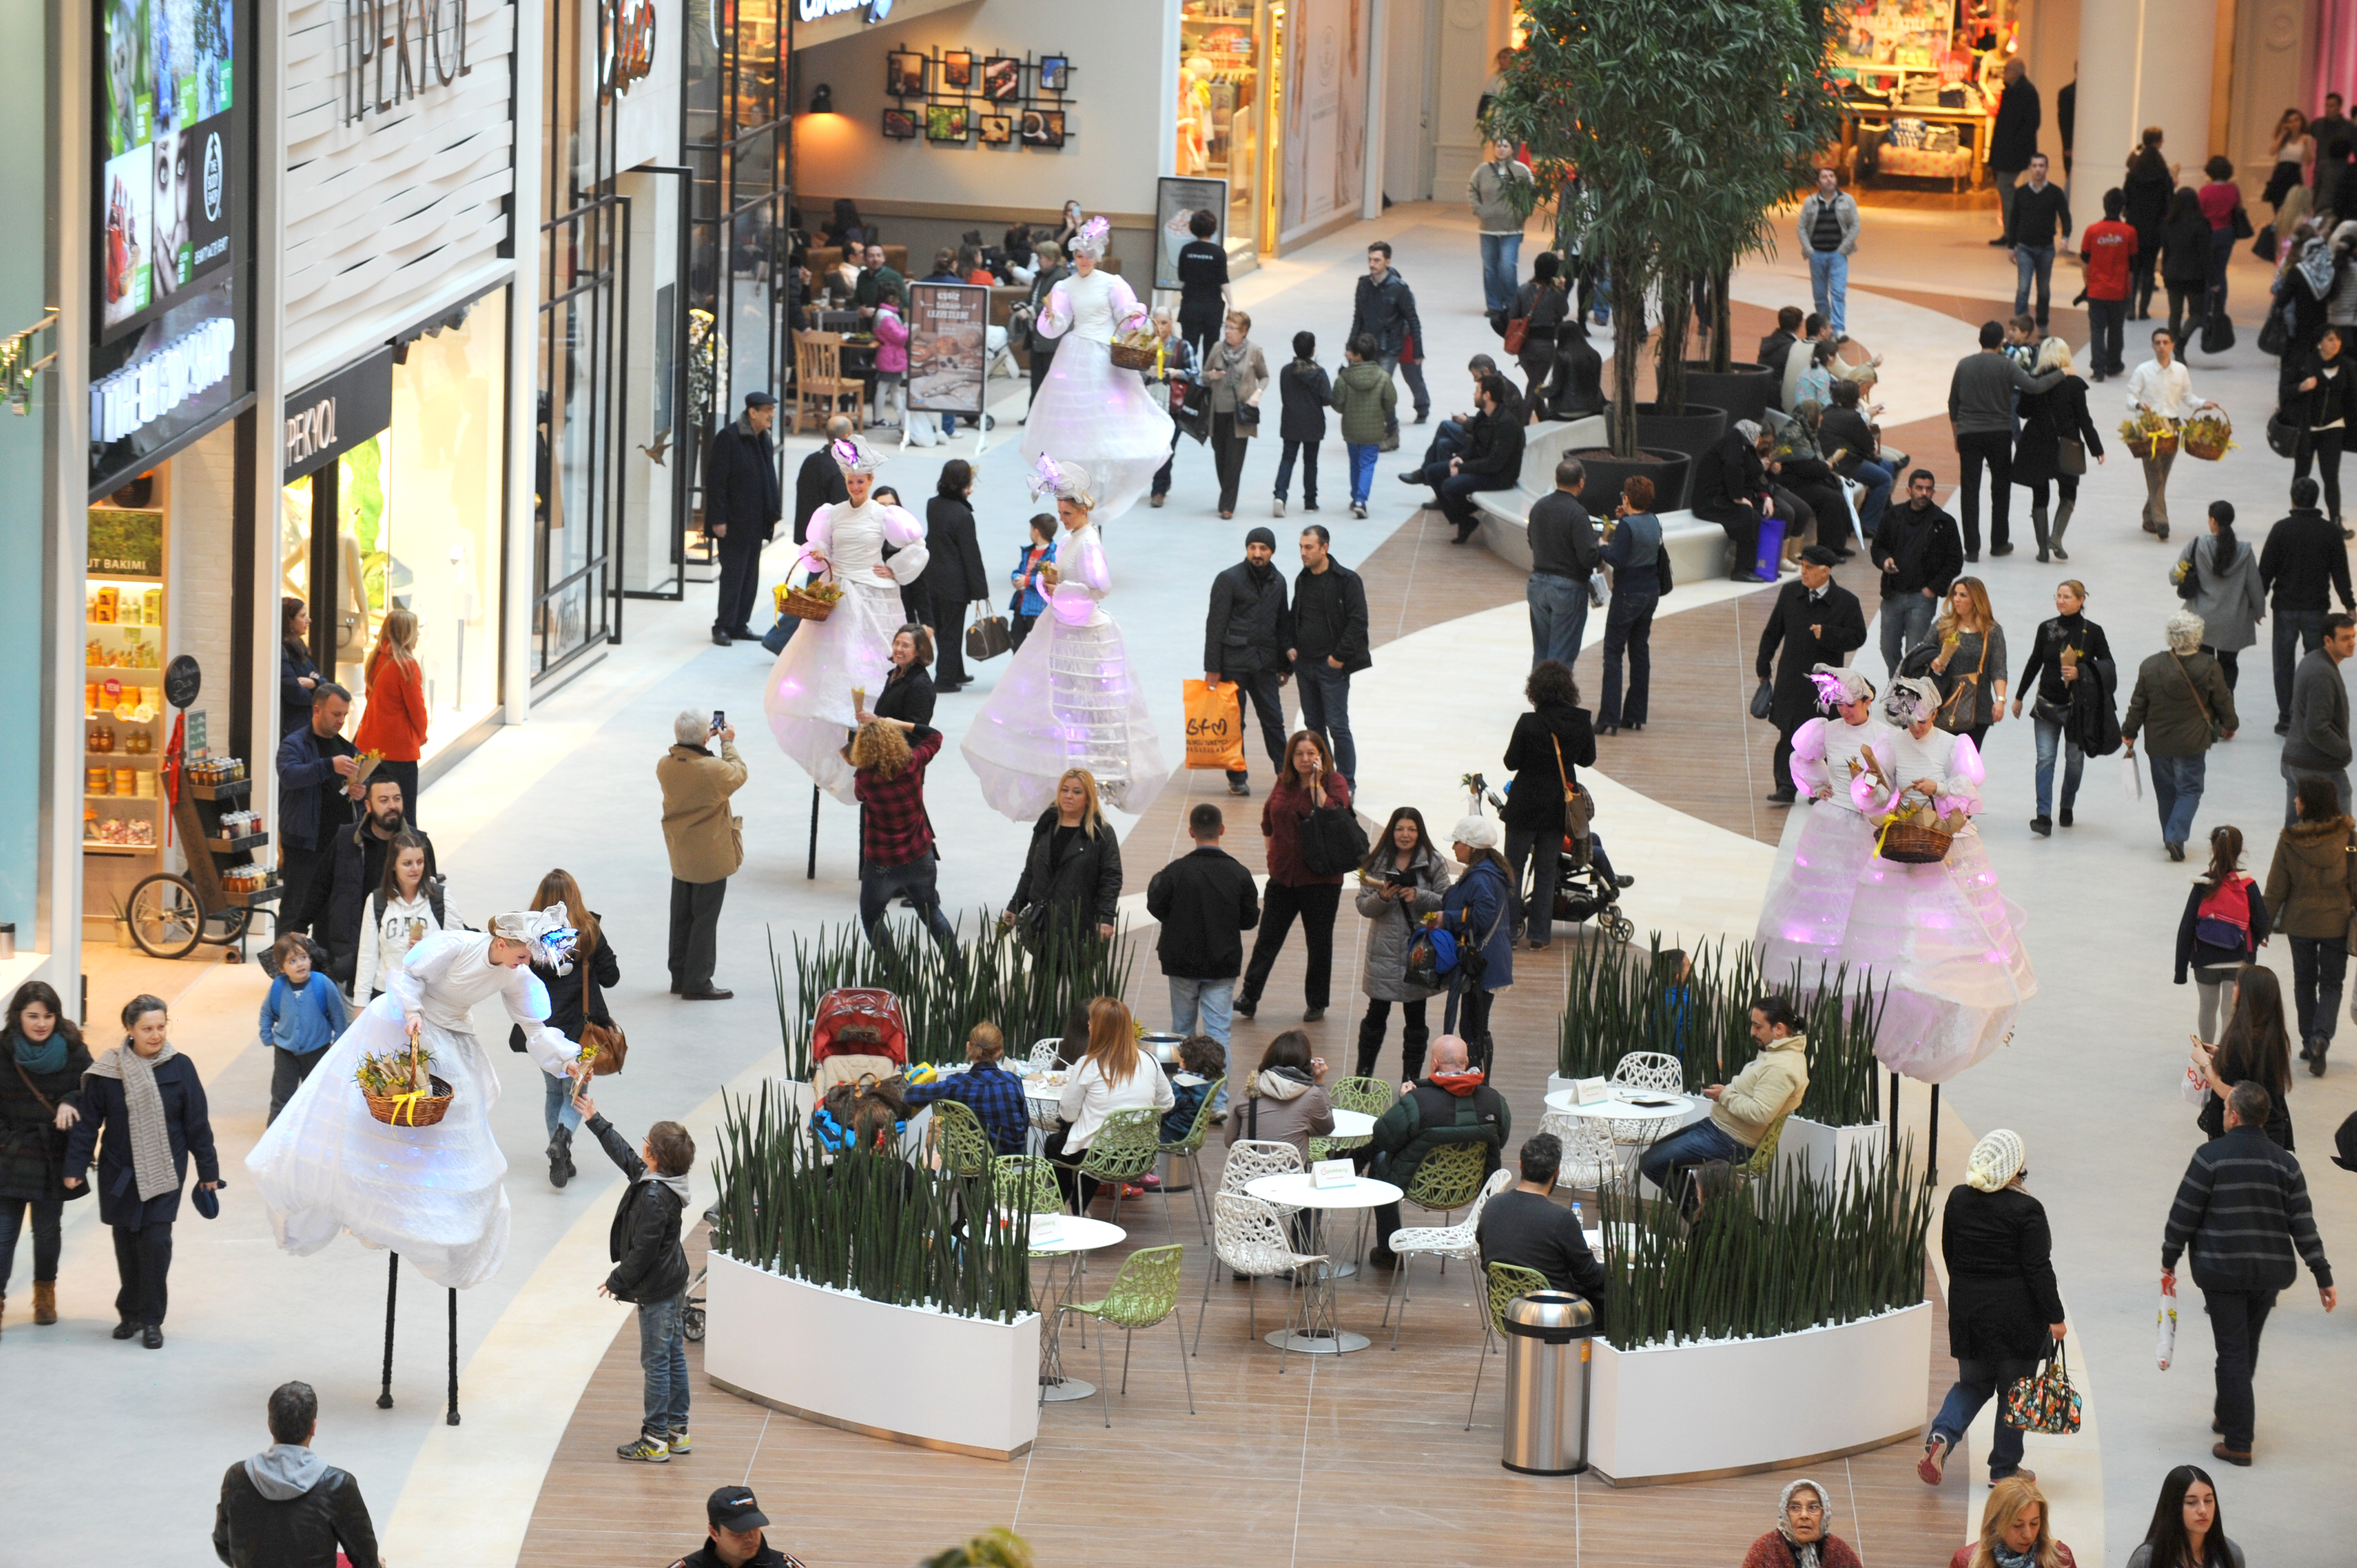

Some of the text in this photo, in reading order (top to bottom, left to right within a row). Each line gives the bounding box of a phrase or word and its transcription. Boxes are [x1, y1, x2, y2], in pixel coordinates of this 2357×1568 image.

[208, 172, 219, 191] BODY
[208, 189, 218, 205] SHOP
[187, 317, 235, 394] SHOP
[104, 559, 146, 570] BAKIMI
